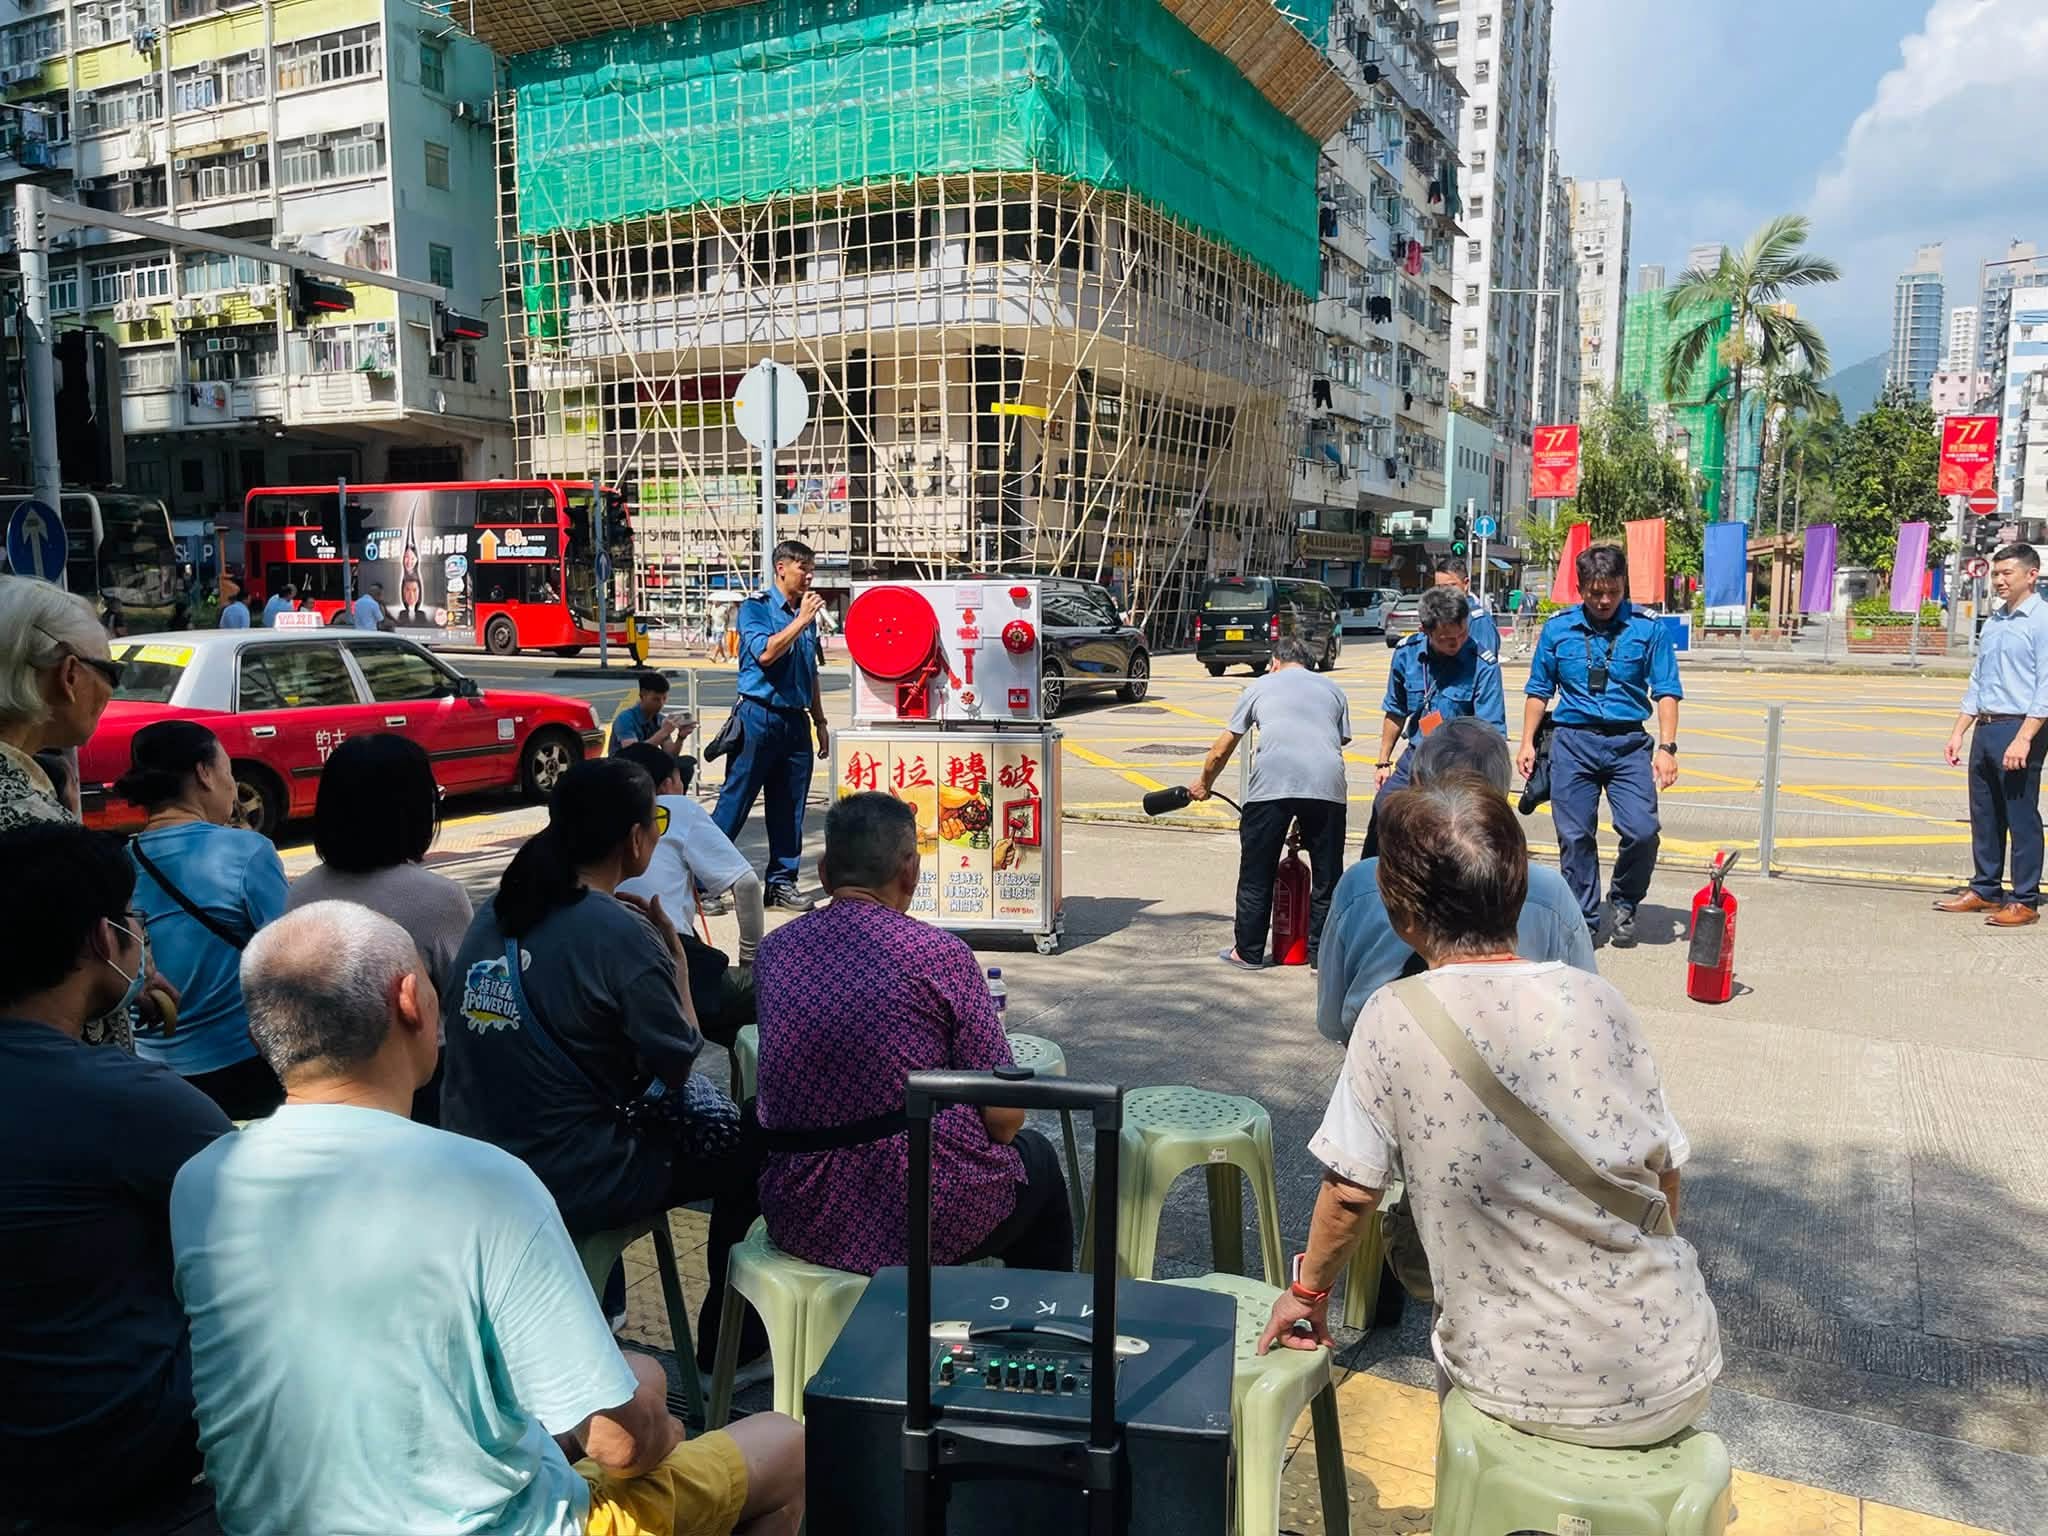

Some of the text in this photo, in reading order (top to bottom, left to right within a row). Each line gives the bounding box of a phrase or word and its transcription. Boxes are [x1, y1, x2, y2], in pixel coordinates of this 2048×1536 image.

[1544, 429, 1569, 450] 77
[1956, 420, 1985, 444] 77
[316, 728, 346, 747] 的士
[317, 746, 333, 763] TA
[844, 751, 1039, 795] 射 拉 轉 破
[961, 855, 970, 868] 2
